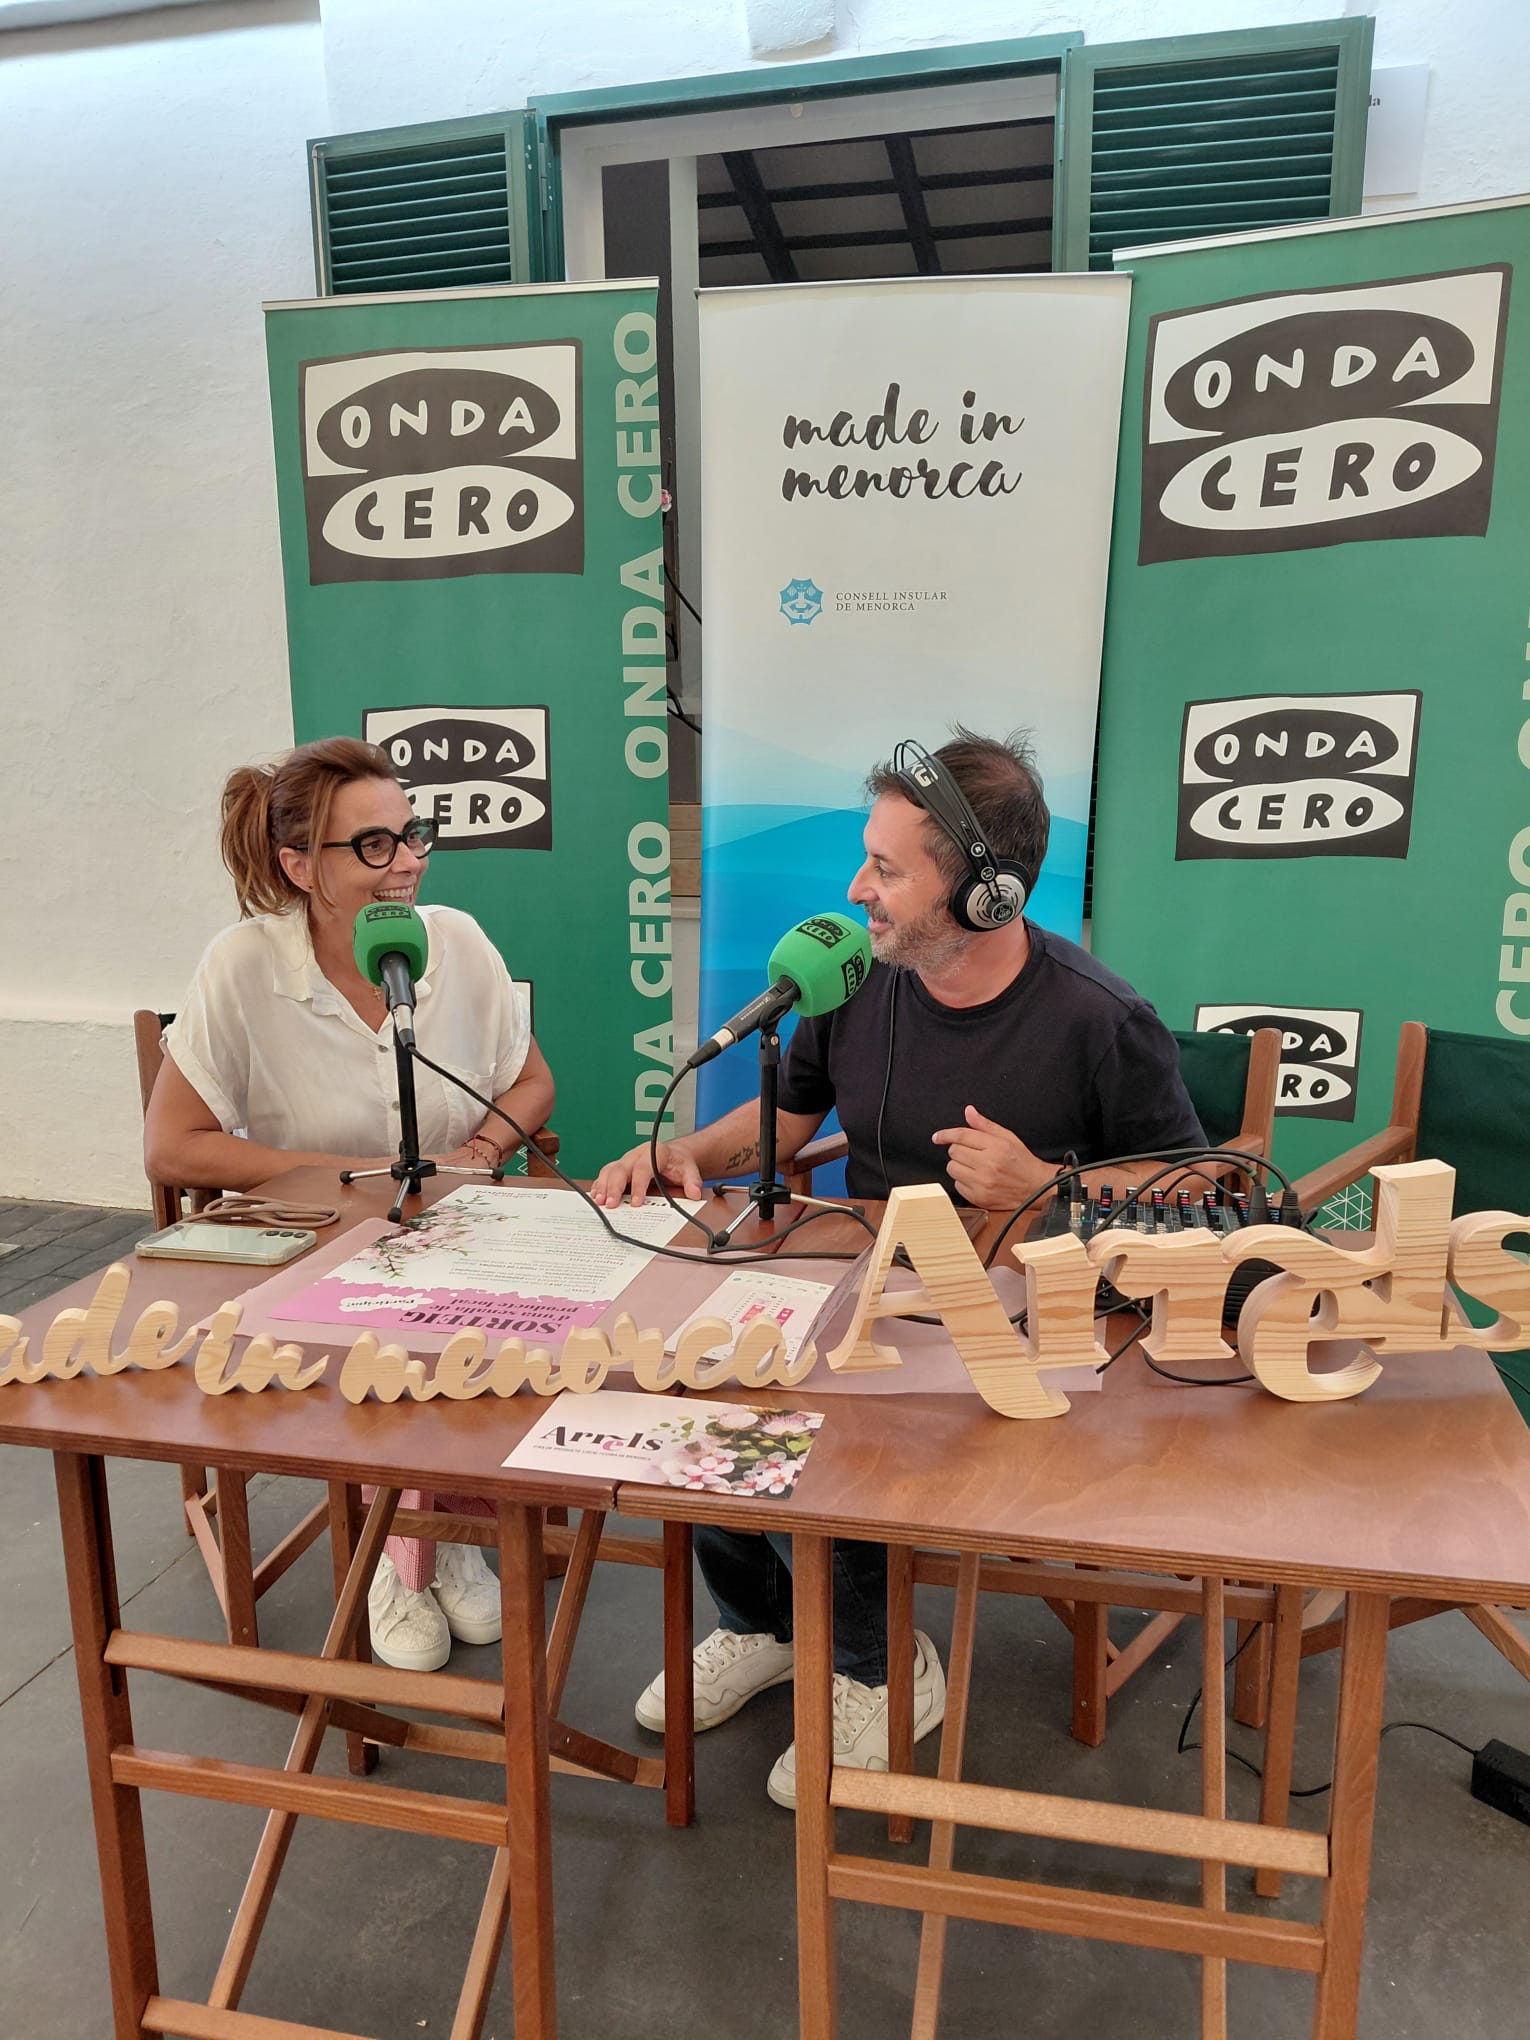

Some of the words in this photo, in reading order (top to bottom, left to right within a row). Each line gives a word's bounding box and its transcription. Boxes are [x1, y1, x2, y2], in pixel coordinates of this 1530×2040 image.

[1194, 336, 1440, 408] ONDA
[340, 396, 535, 449] ONDA
[613, 311, 663, 518] CERO
[783, 382, 939, 450] made
[960, 390, 1025, 444] in
[782, 458, 1022, 501] menorca
[1201, 441, 1436, 511] CERO
[354, 486, 539, 541] CERO
[836, 592, 889, 601] CONSELL
[894, 591, 948, 601] INSULAR
[836, 602, 852, 611] DE
[856, 602, 916, 611] MENORCA
[620, 546, 669, 779] ONDA
[391, 738, 520, 766] ONDA
[1214, 730, 1377, 764] ONDA
[1218, 792, 1374, 830] CERO
[627, 821, 673, 998] CERO
[806, 925, 833, 941] CERO
[633, 1019, 675, 1137] DA
[1280, 1073, 1330, 1099] RO
[429, 1303, 450, 1312] de
[451, 1298, 492, 1309] local
[497, 1303, 579, 1313] producte
[522, 1311, 571, 1322] d'una
[0, 1262, 199, 1386] ade
[194, 1300, 330, 1395] in
[340, 1313, 818, 1404] menorca
[400, 1311, 562, 1334] SORTEIG
[540, 1426, 663, 1451] Arrels
